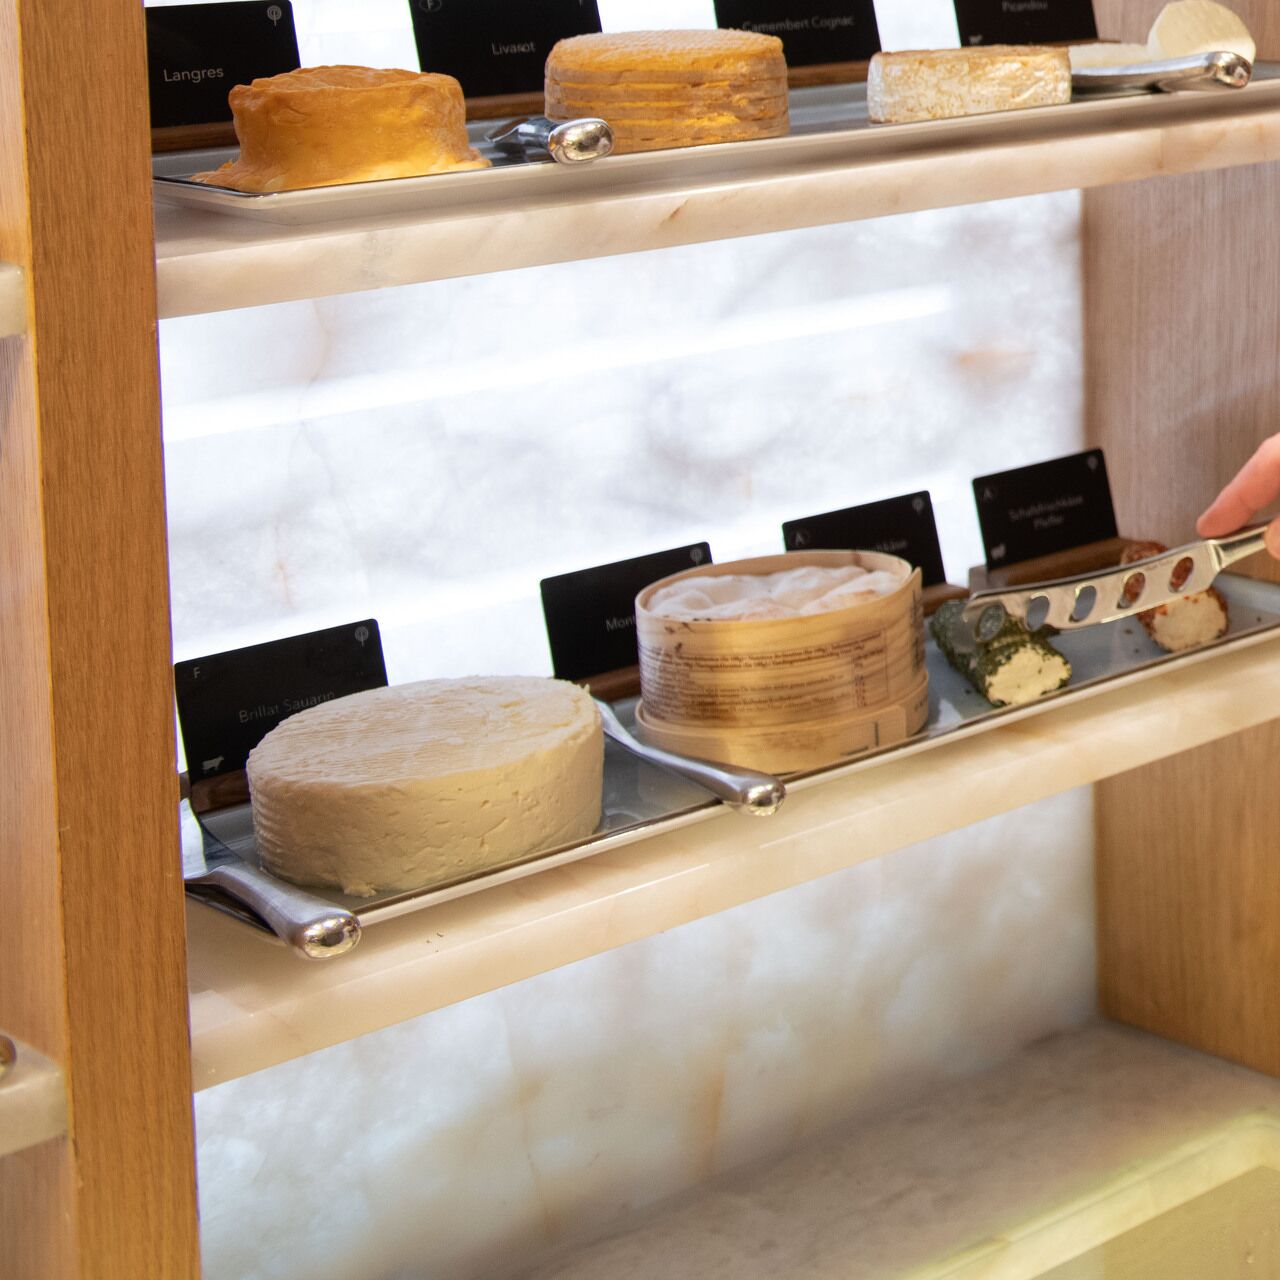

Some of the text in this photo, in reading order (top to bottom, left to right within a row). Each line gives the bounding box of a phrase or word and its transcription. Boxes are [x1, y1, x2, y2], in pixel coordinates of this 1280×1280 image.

[1001, 0, 1049, 13] Picandou
[742, 15, 856, 34] Camembert Cognac
[491, 40, 536, 56] Livarot
[163, 65, 225, 83] Langres
[238, 703, 281, 724] Brillat
